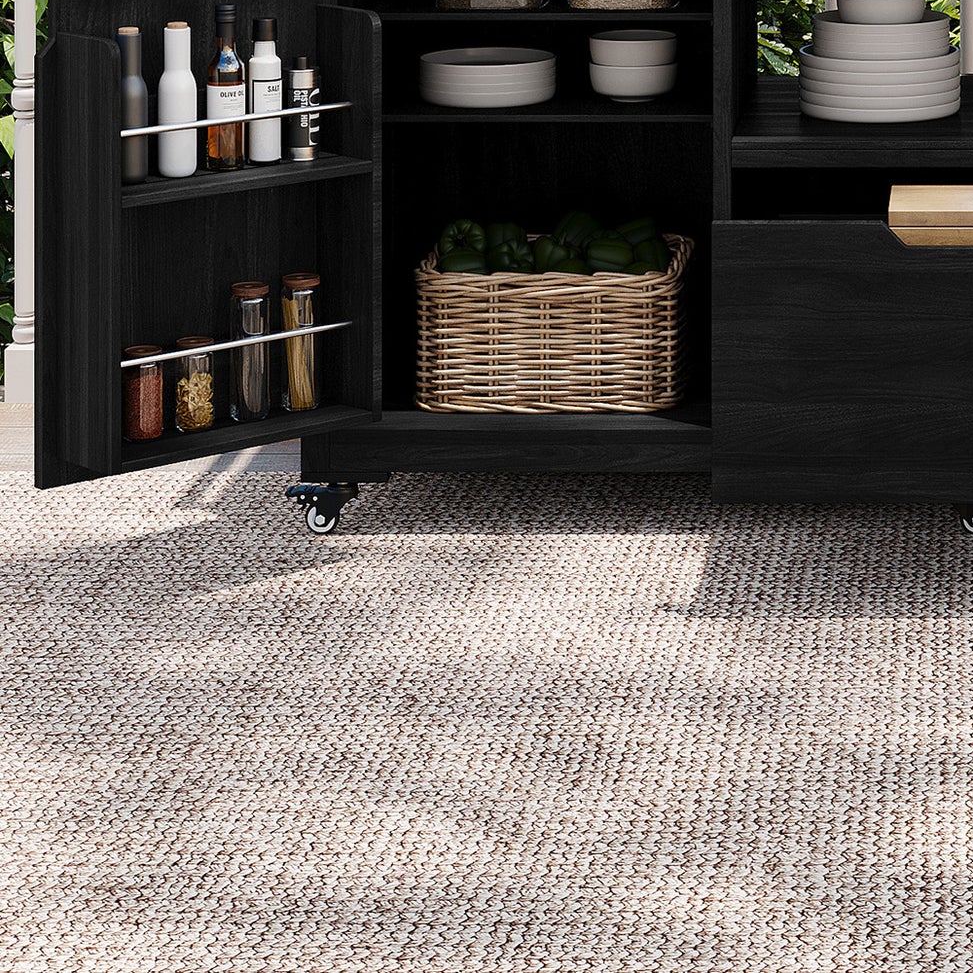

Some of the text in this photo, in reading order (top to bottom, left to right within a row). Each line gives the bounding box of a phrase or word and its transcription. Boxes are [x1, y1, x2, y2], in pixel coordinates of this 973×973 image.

[267, 84, 280, 93] SALT
[293, 90, 301, 102] OIL
[300, 89, 309, 128] PISTHIO
